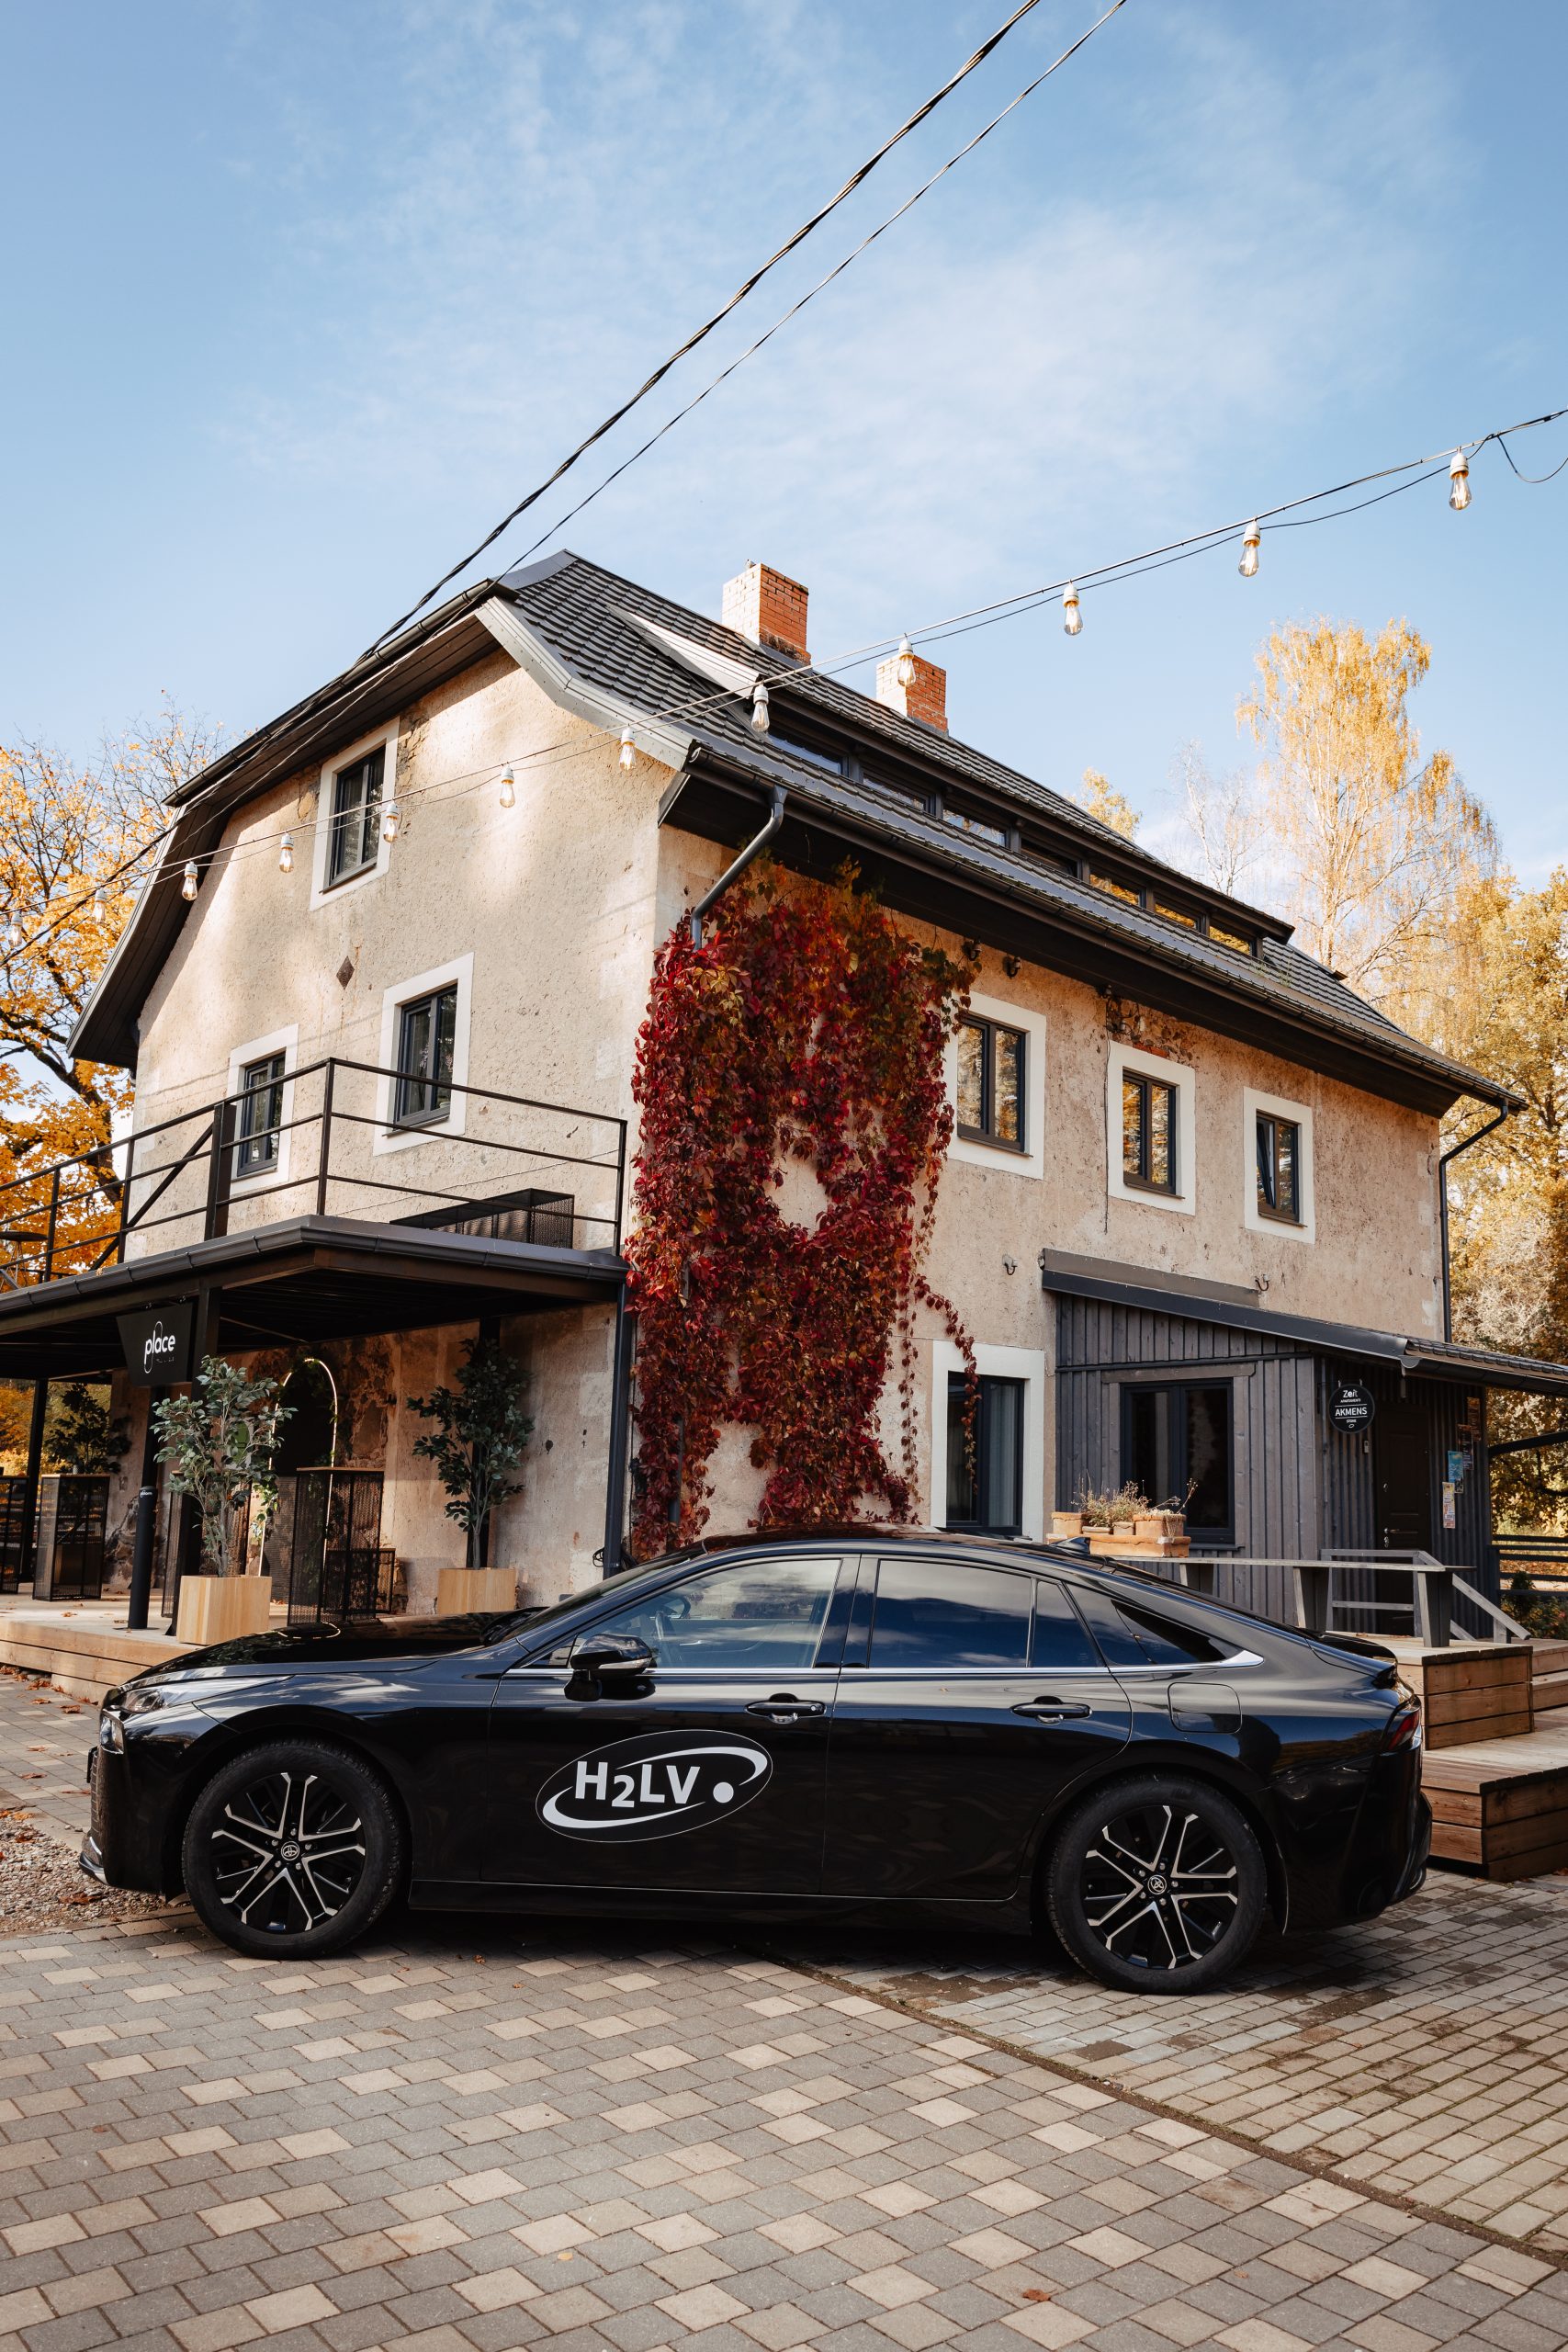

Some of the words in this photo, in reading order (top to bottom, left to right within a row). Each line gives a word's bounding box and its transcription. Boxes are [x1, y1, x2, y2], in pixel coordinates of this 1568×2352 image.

[143, 1320, 176, 1374] place
[1342, 1388, 1359, 1397] Zeit
[1335, 1407, 1368, 1417] AKMENS
[575, 1760, 701, 1808] H2LV
